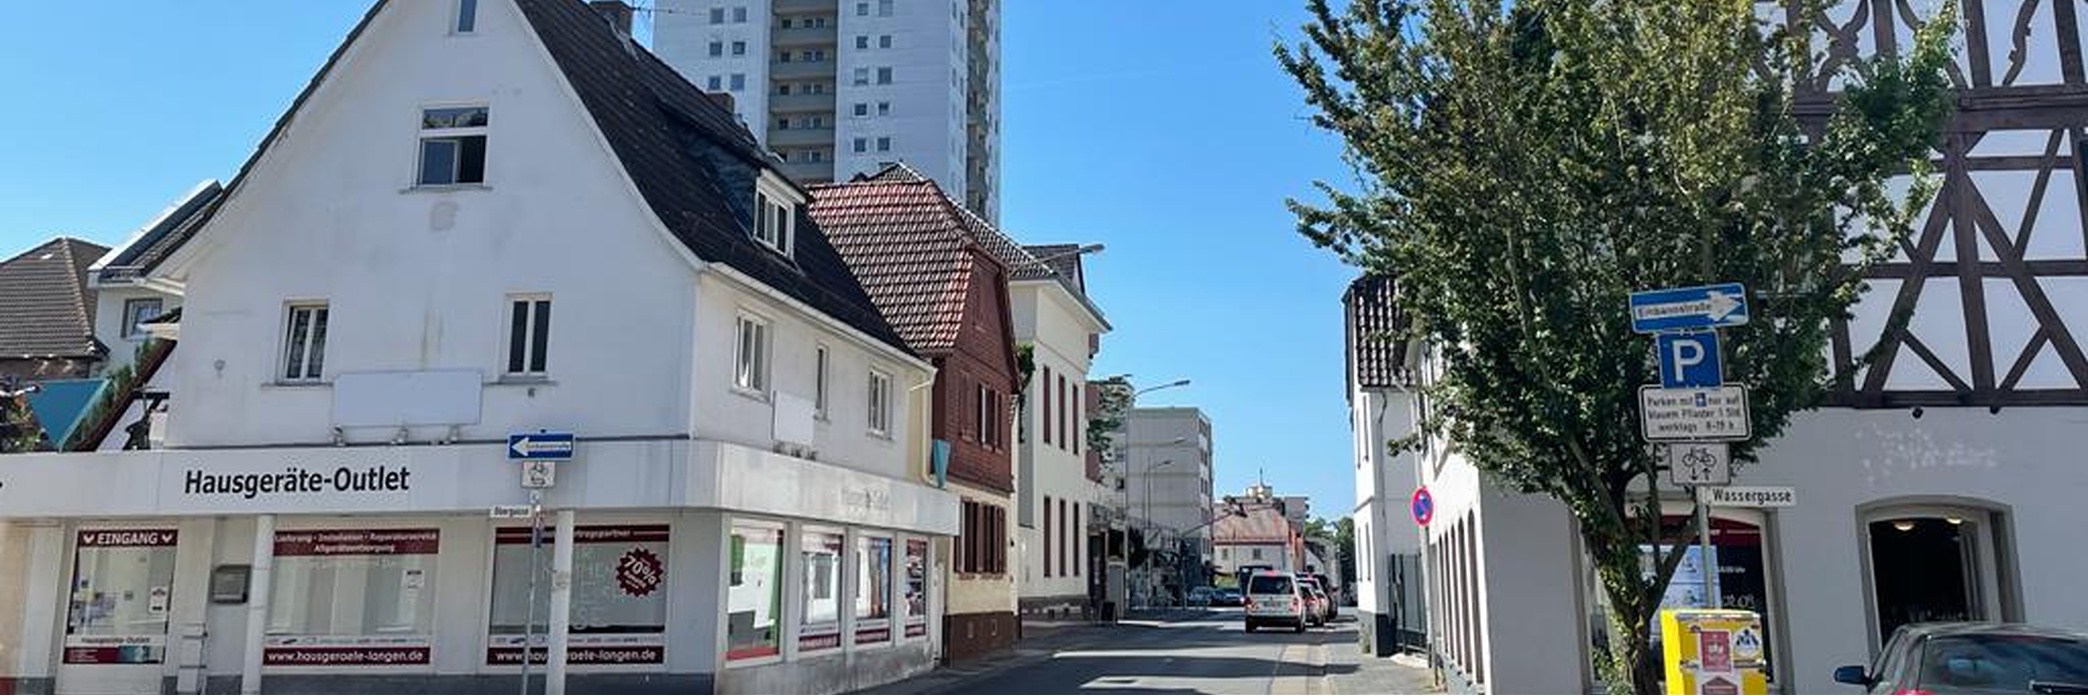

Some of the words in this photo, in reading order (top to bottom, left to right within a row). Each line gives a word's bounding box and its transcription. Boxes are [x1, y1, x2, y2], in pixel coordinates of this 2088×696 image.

[1673, 339, 1705, 383] P
[1648, 397, 1678, 407] Parken
[184, 466, 410, 499] Hausgeräte-Outlet
[1712, 488, 1791, 506] Wassergasse
[97, 532, 159, 545] EINGANG
[624, 555, 657, 585] 70%
[267, 651, 424, 664] www.hausgeraete-langen.de
